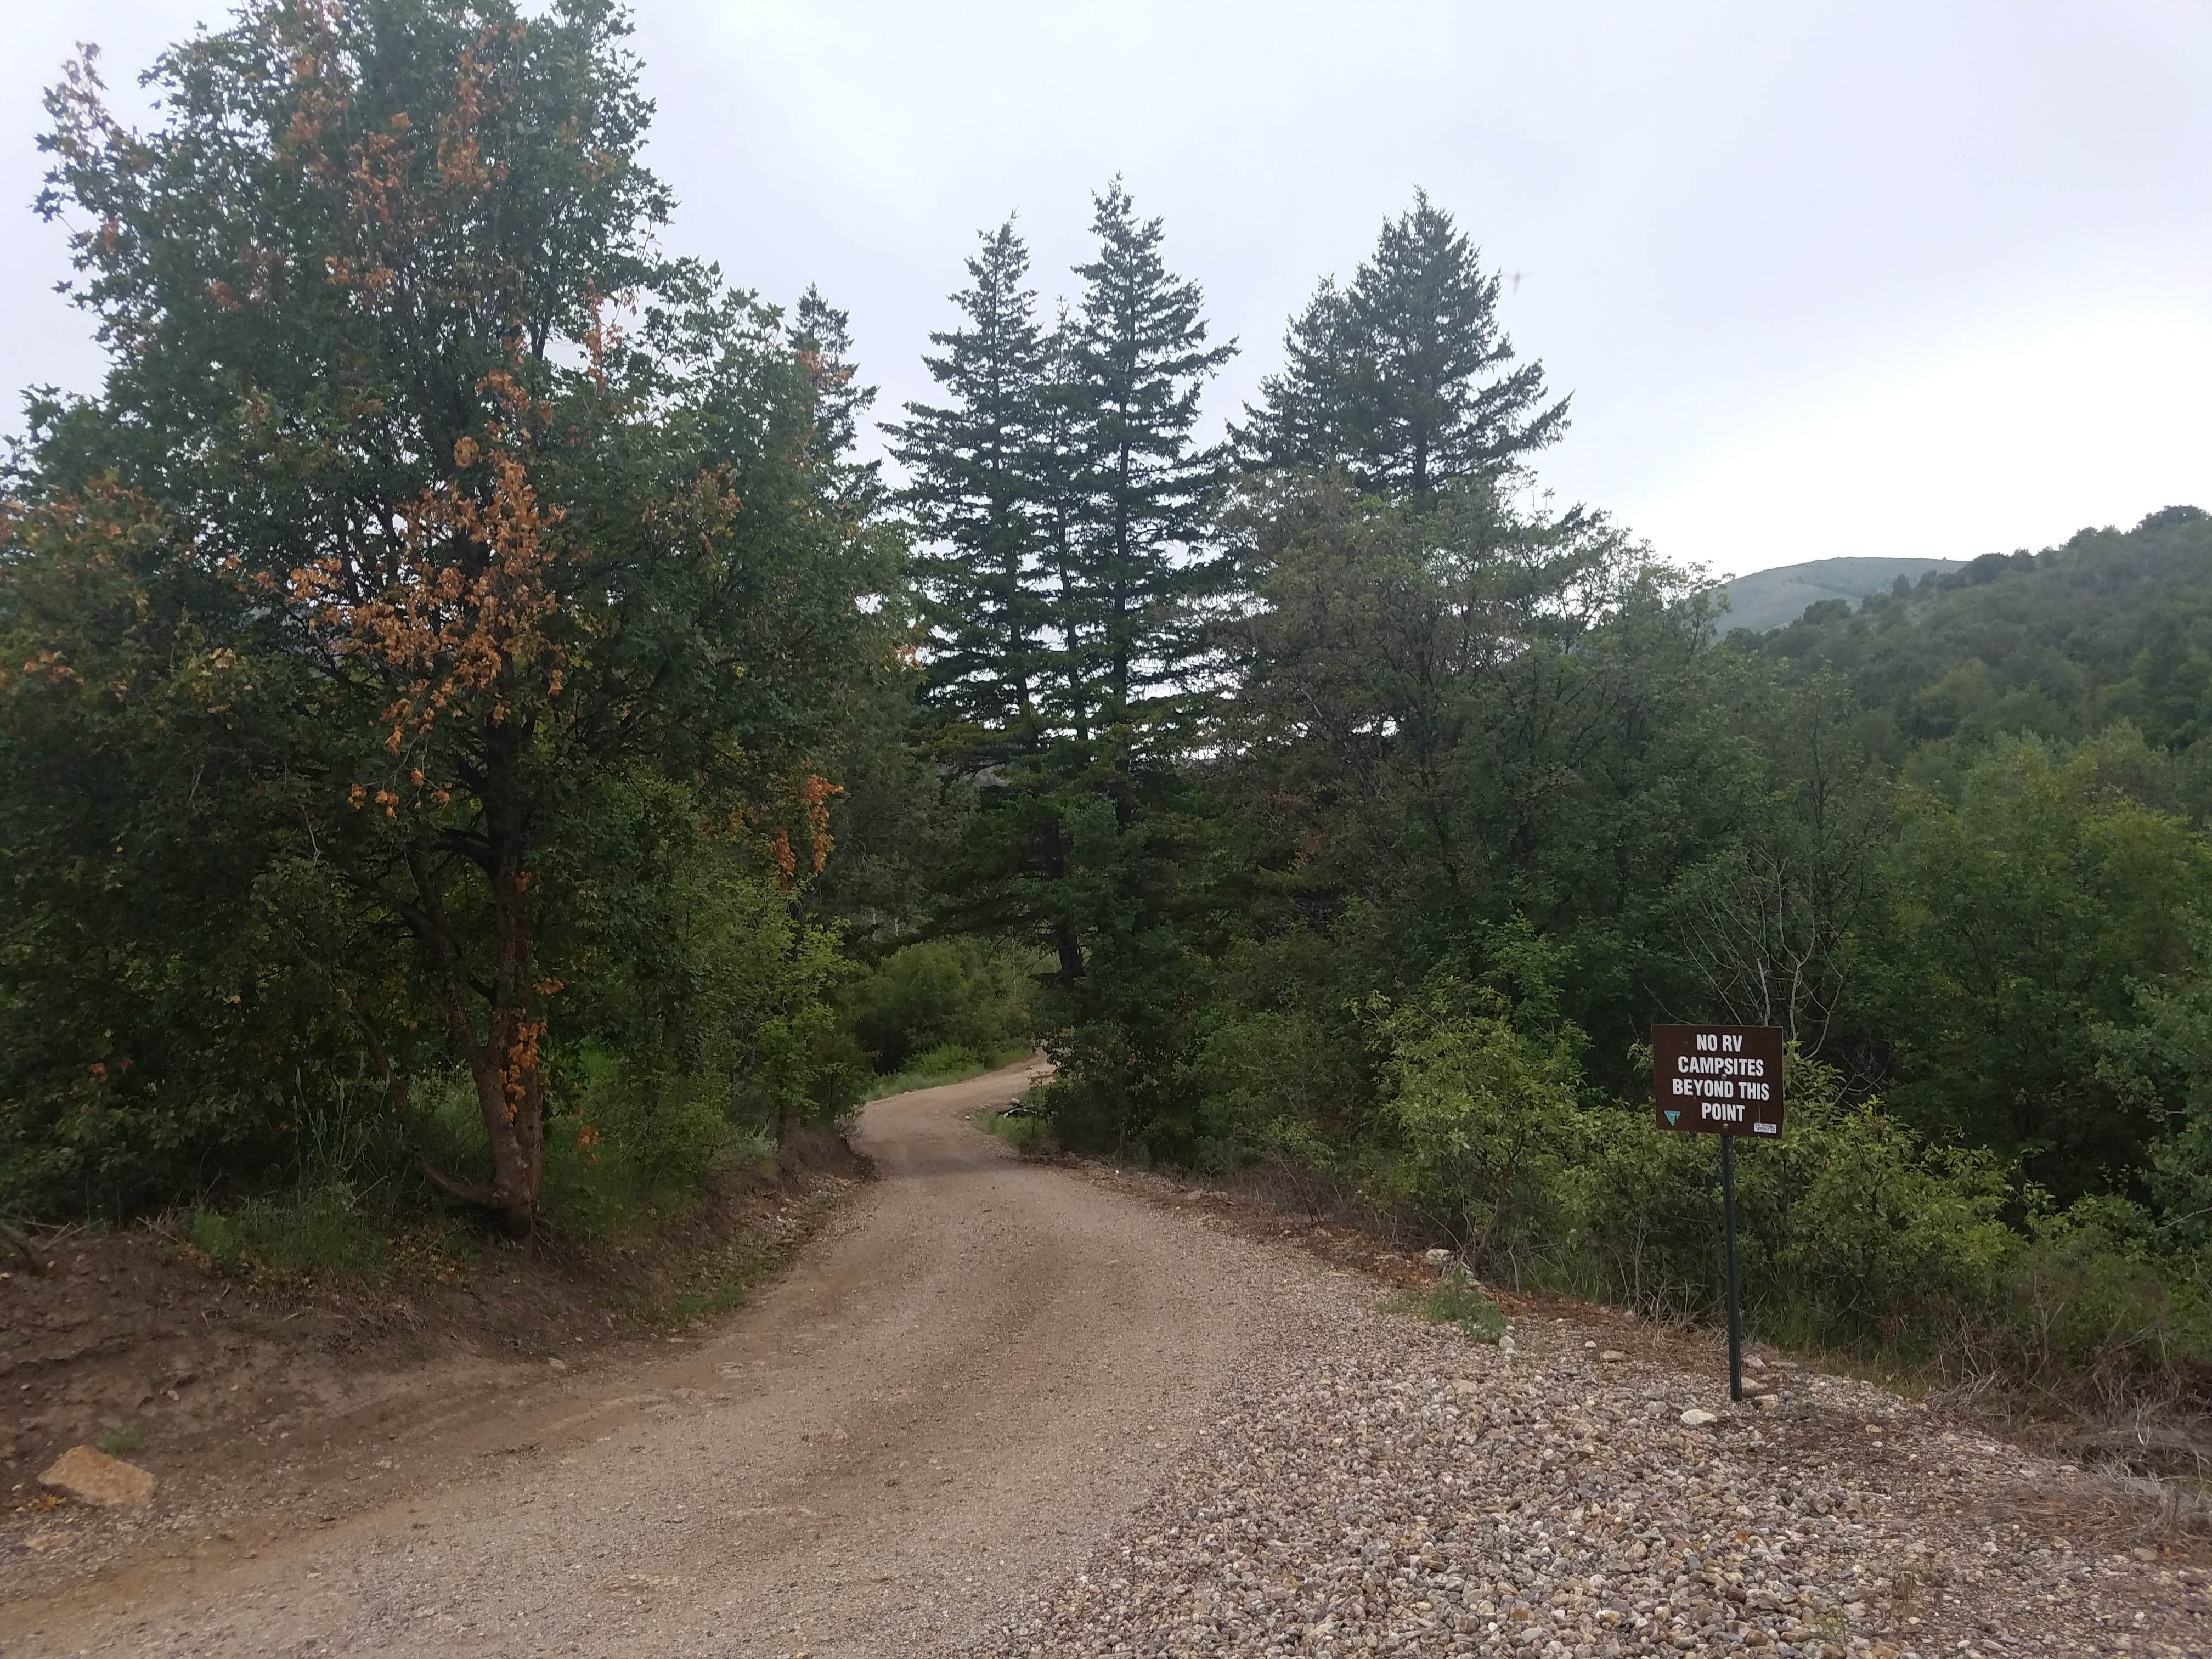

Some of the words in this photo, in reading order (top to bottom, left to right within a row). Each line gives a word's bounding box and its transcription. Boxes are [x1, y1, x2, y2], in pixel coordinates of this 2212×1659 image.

[1697, 1034, 1717, 1051] NO
[1722, 1035, 1743, 1052] RV
[1678, 1056, 1764, 1076] CAMPSITES
[1672, 1078, 1734, 1098] BEYOND
[1738, 1081, 1769, 1101] THIS
[1702, 1102, 1745, 1122] POINT
